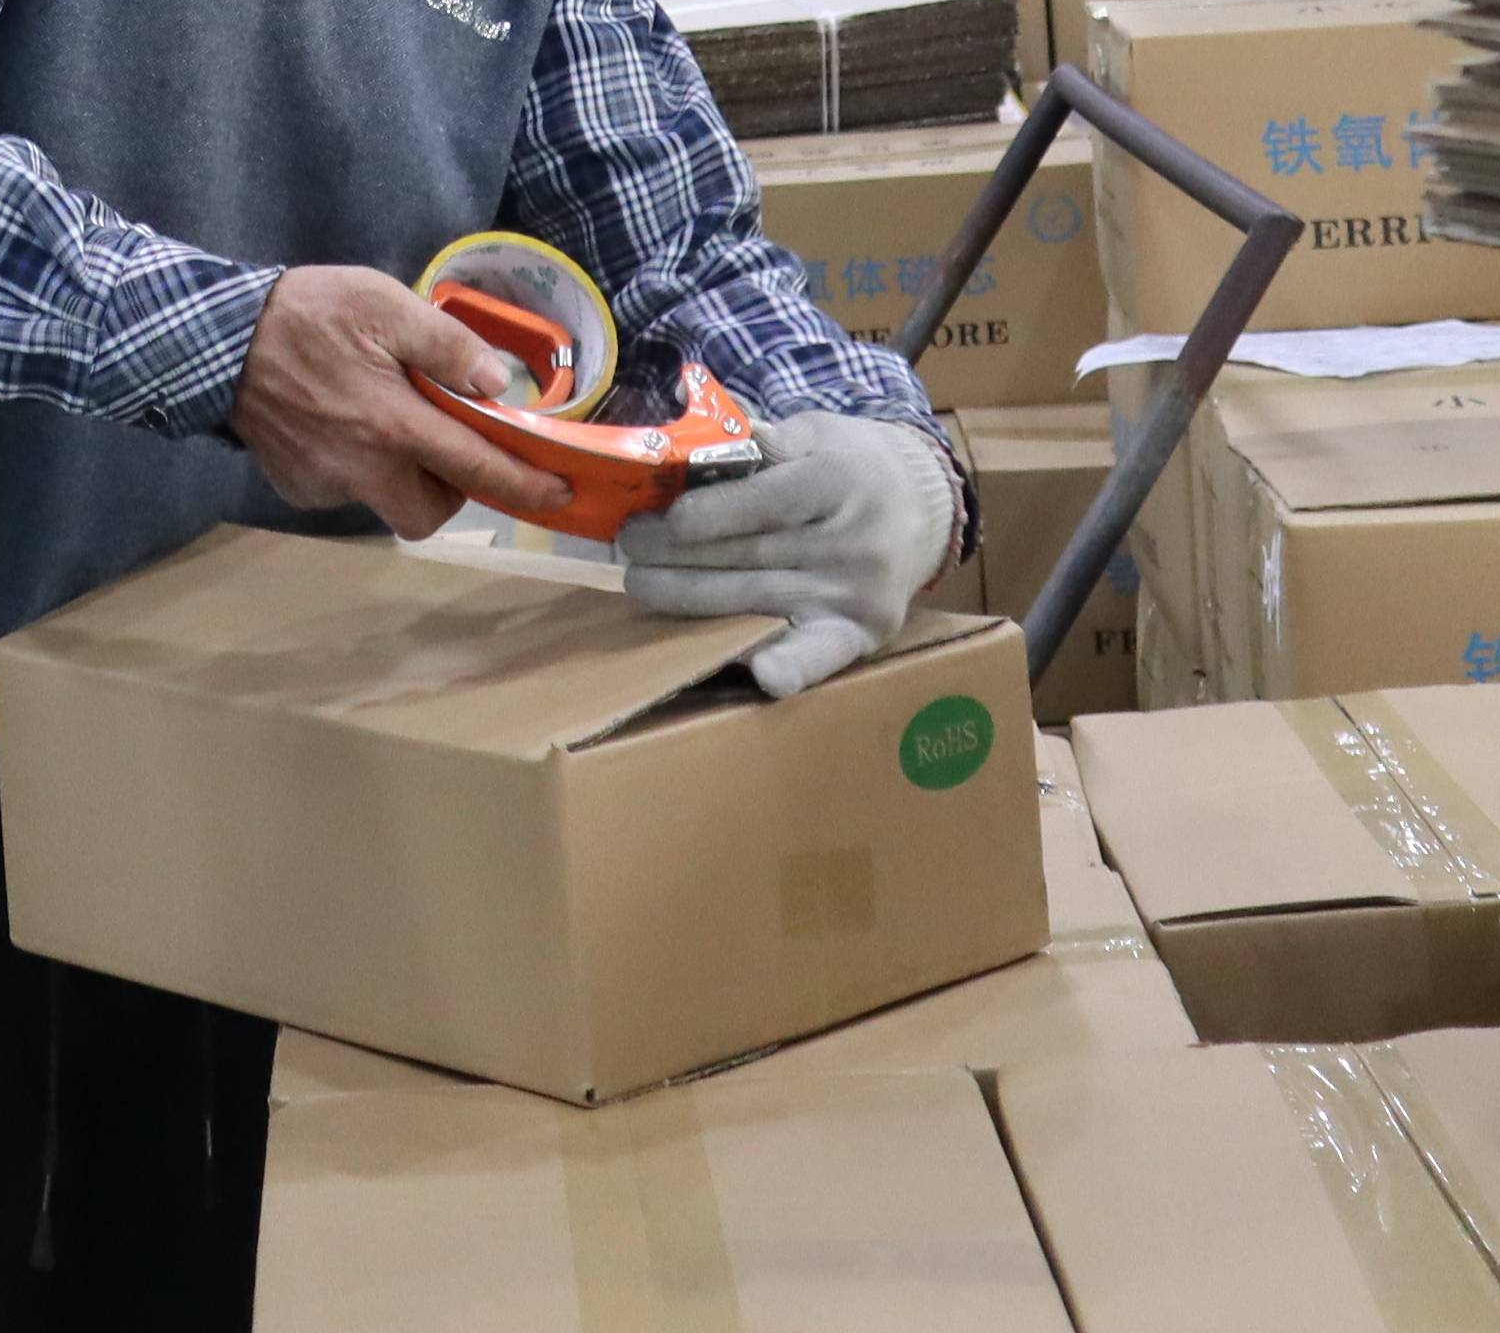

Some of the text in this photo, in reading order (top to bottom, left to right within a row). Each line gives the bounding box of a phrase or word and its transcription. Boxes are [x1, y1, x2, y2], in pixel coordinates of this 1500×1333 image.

[802, 253, 998, 302] 氧体磁芯
[928, 320, 1010, 349] ORE
[916, 720, 978, 767] RoHS
